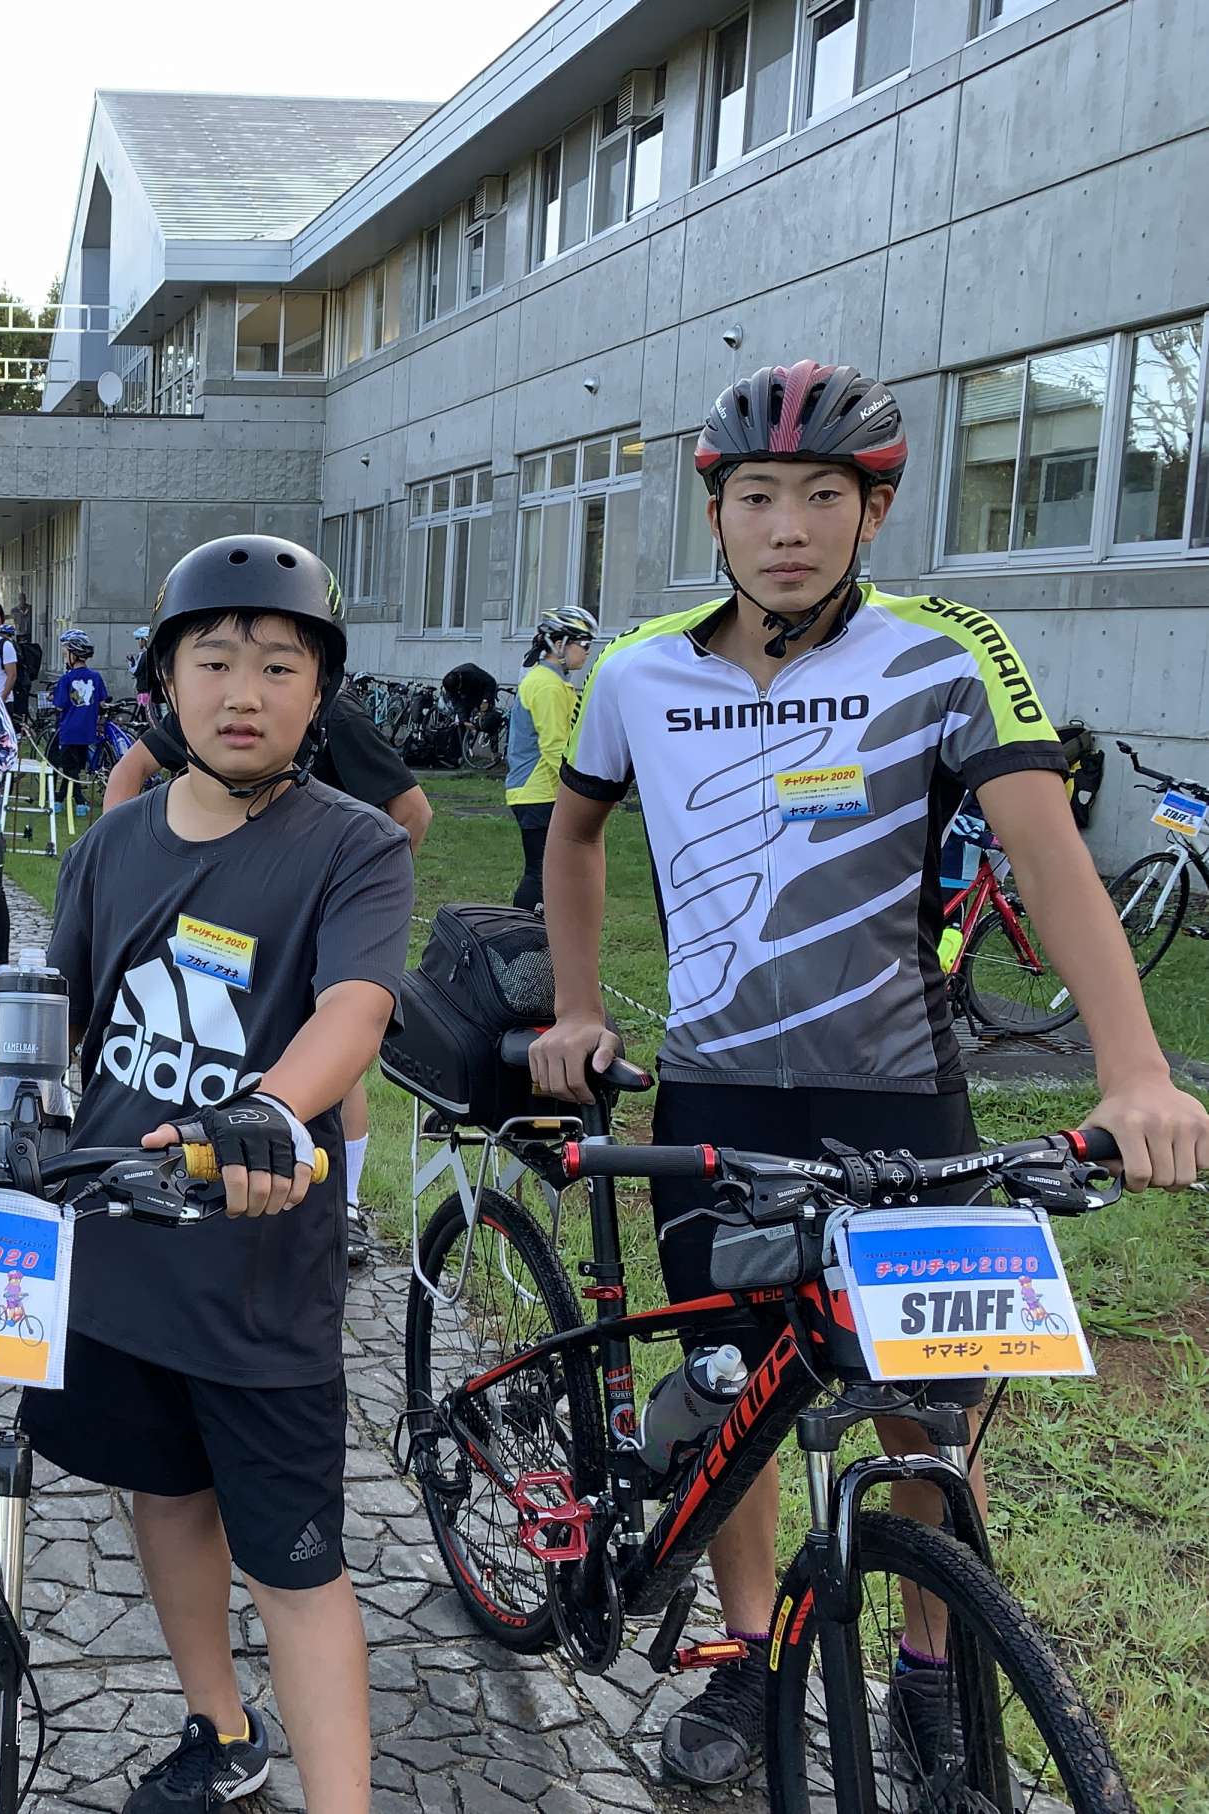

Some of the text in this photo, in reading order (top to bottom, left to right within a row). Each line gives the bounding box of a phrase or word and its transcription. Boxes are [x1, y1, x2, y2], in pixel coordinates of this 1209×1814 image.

[919, 596, 1043, 724] SHIMANO
[666, 694, 870, 732] SHIMANO
[831, 770, 856, 781] 2020
[790, 800, 862, 816] ヤマギシ ユウト
[1163, 808, 1189, 822] STAFF
[225, 936, 248, 950] 2020
[186, 954, 239, 979] フカイ アオネ
[95, 1024, 265, 1109] dida
[900, 1289, 1015, 1335] STAFF
[922, 1340, 1041, 1359] ヤマギシ ユウト
[289, 1540, 328, 1562] adidas
